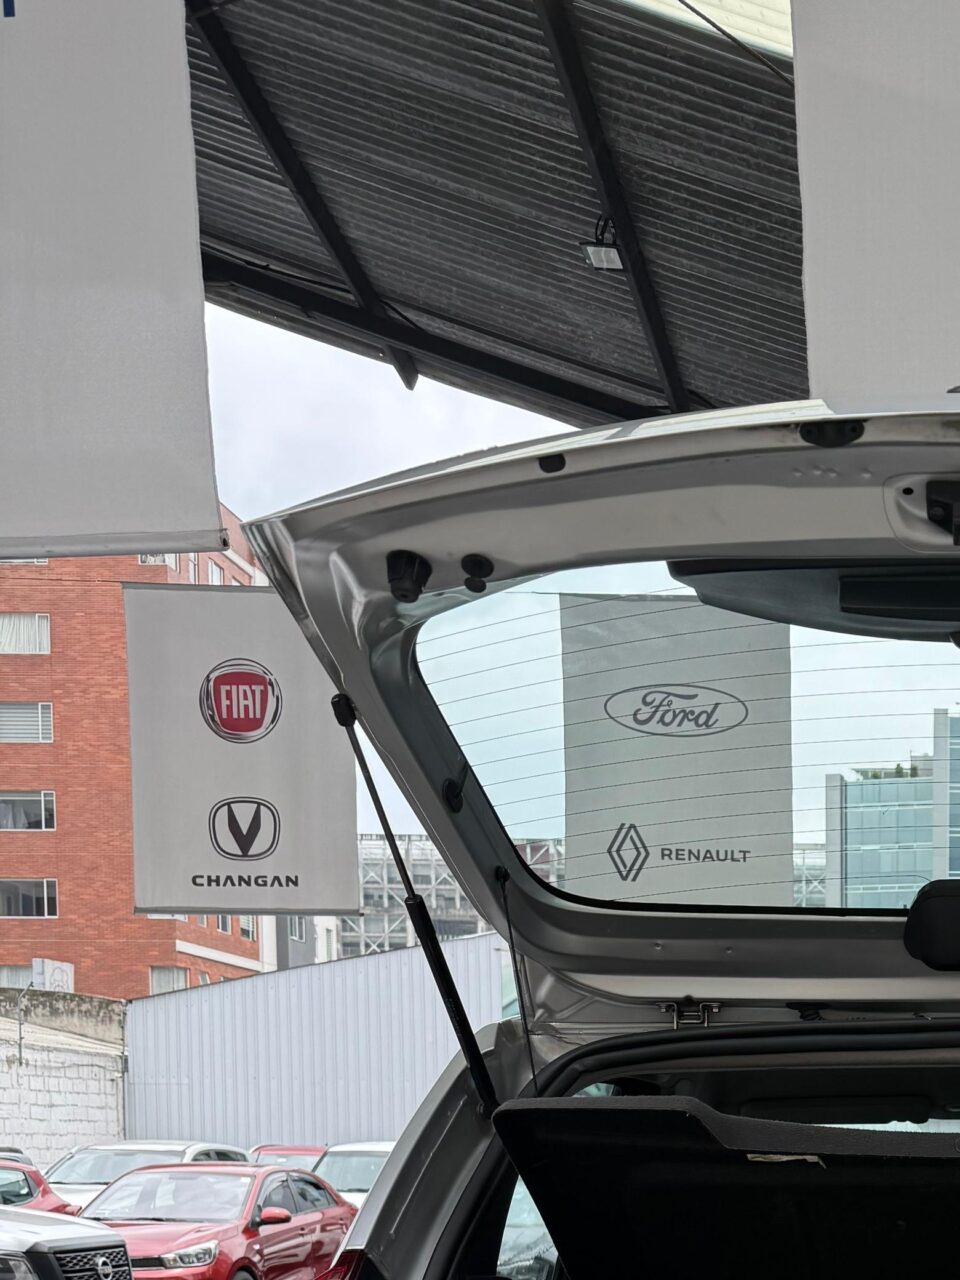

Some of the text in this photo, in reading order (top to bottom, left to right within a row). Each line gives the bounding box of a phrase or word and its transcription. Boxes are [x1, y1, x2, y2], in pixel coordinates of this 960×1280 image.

[219, 684, 265, 719] FIAT
[632, 690, 721, 729] Ford
[660, 847, 751, 863] RENAULT
[191, 874, 299, 888] CHANGAN
